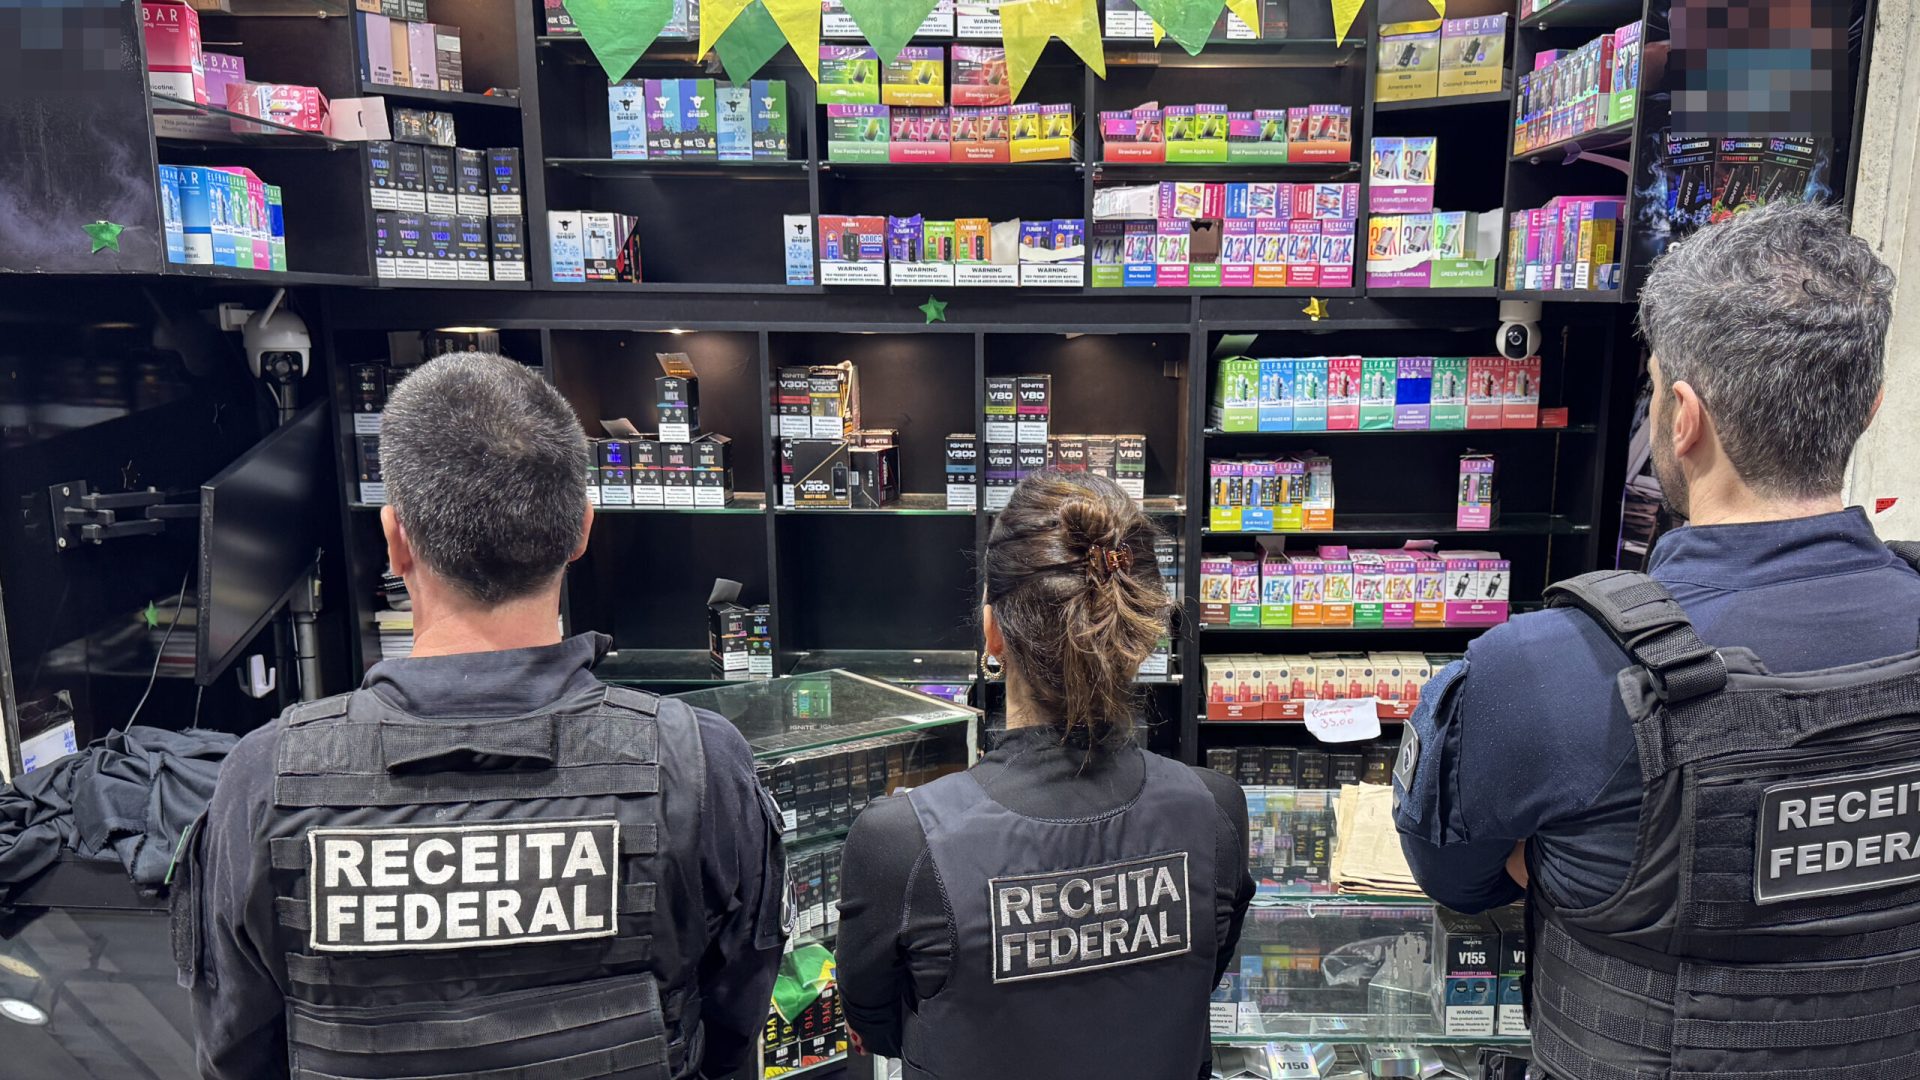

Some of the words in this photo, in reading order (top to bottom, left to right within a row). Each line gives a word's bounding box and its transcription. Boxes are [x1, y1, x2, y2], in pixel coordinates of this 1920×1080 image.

[1448, 17, 1500, 32] ELFBAR
[306, 89, 318, 129] ELFBAR
[1668, 144, 1682, 154] V55
[1721, 141, 1735, 151] V55
[1770, 140, 1785, 152] V55
[1684, 182, 1693, 206] IGNITE
[1728, 181, 1740, 204] IGNITE
[1227, 362, 1257, 370] ELFBAR
[1261, 361, 1292, 369] ELFBAR
[1296, 361, 1327, 369] ELFBAR
[1363, 361, 1395, 369] ELFBAR
[779, 380, 808, 388] V300
[665, 392, 679, 400] MIX
[989, 392, 1013, 400] V80
[1020, 392, 1045, 400] V80
[639, 454, 653, 463] MIX
[670, 455, 684, 464] MIX
[701, 455, 714, 464] MIX
[1020, 456, 1044, 464] V80
[1213, 464, 1241, 472] ELFBAR
[754, 626, 767, 634] MIX
[324, 831, 607, 887] RECEITA
[1000, 866, 1181, 927] RECEITA
[327, 885, 604, 942] FEDERAL
[1002, 911, 1181, 972] FEDERAL
[1459, 952, 1486, 964] V155
[1513, 950, 1526, 963] V1
[822, 1001, 832, 1024] V16
[804, 1007, 814, 1029] V16
[767, 1018, 777, 1041] V16
[813, 1036, 825, 1047] RED
[776, 1047, 788, 1058] RED
[1278, 1062, 1309, 1070] V150
